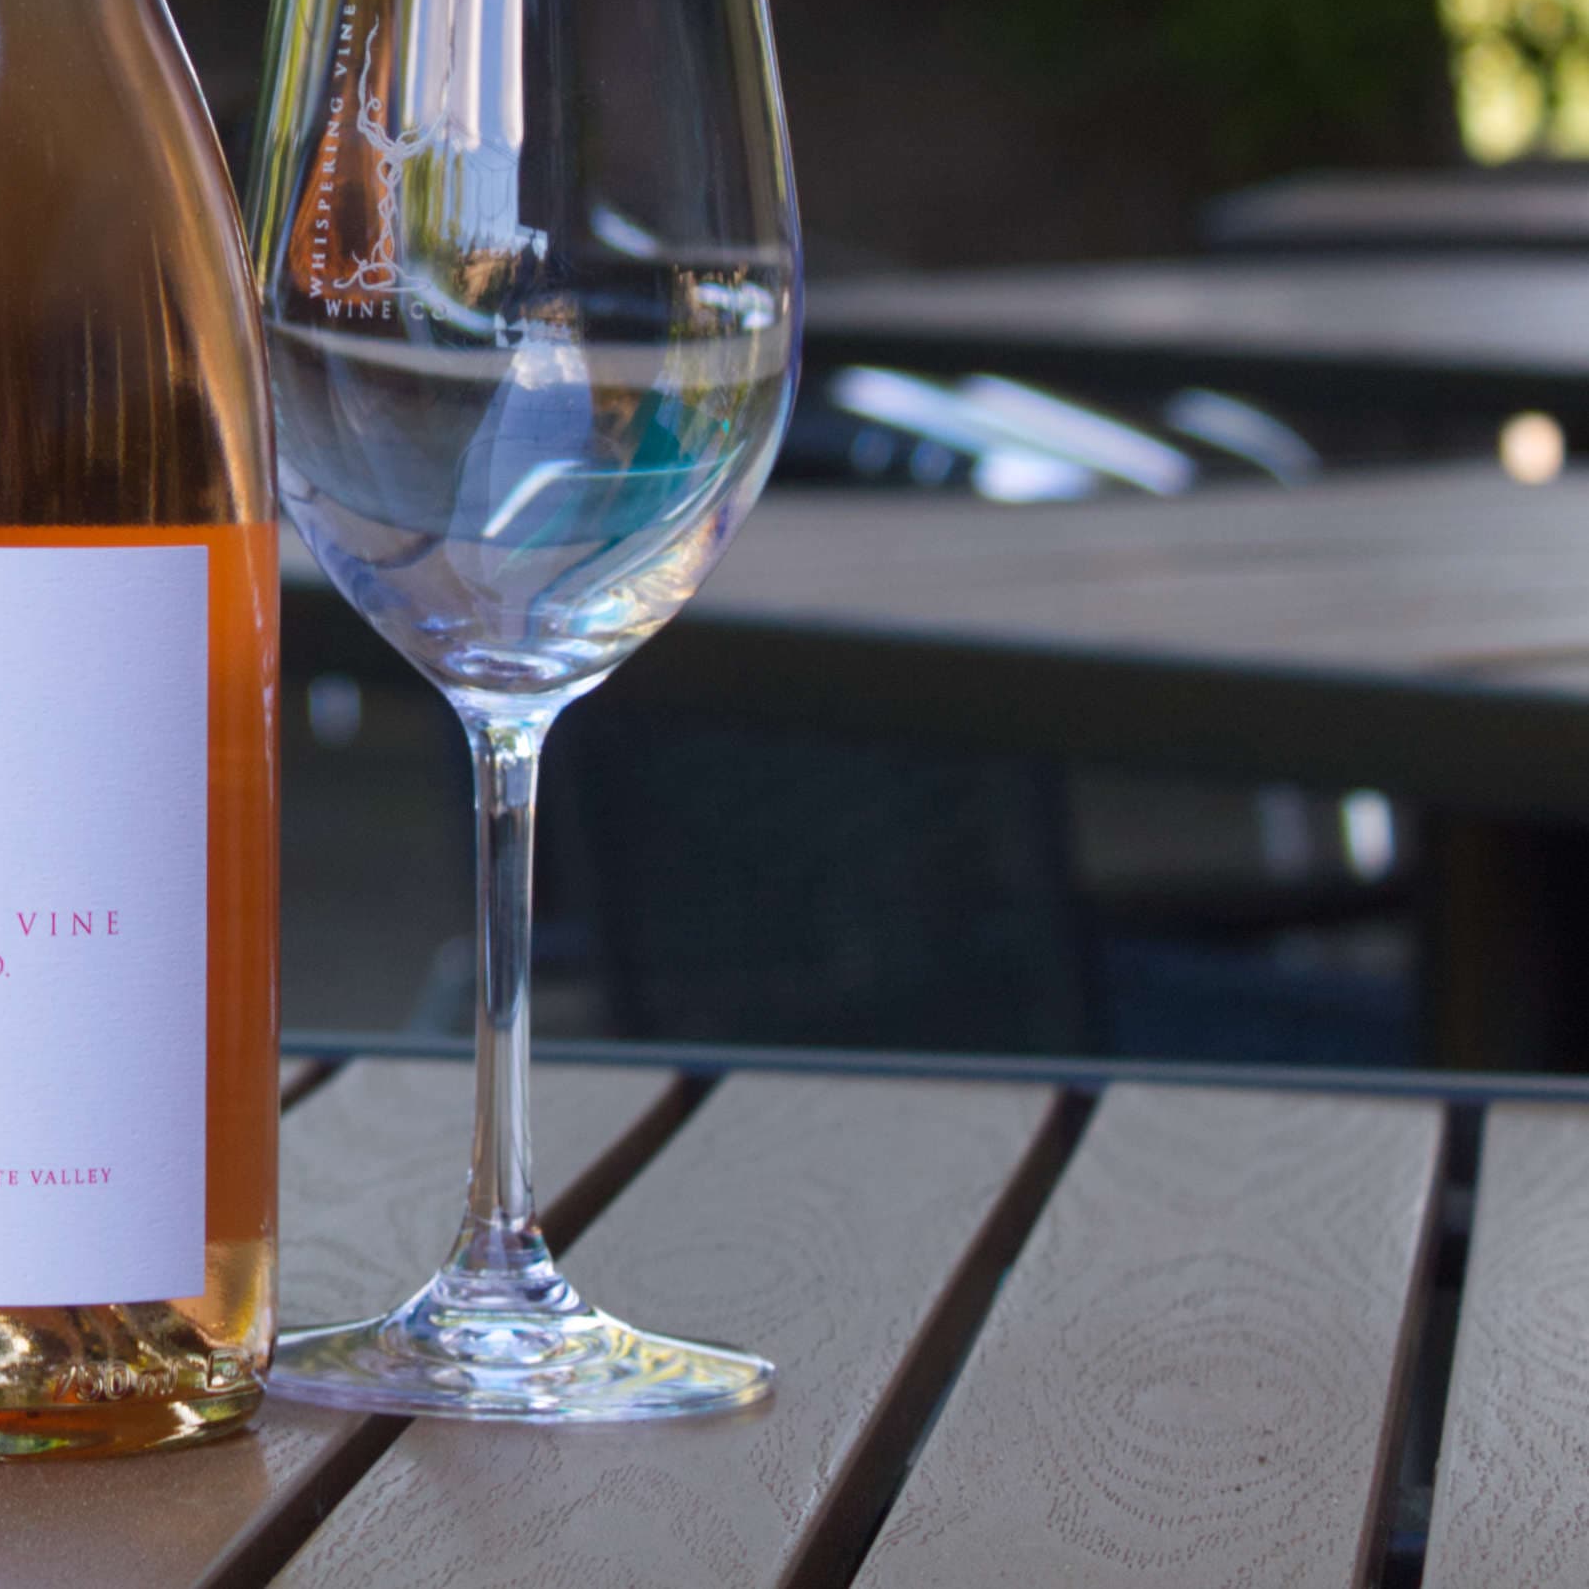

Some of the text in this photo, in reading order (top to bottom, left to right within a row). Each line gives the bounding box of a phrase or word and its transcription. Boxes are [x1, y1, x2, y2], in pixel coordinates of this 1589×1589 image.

[309, 2, 357, 298] WHISPERING VINE
[324, 298, 392, 320] WINE
[16, 909, 122, 938] VINE
[29, 1167, 112, 1186] VALLEY
